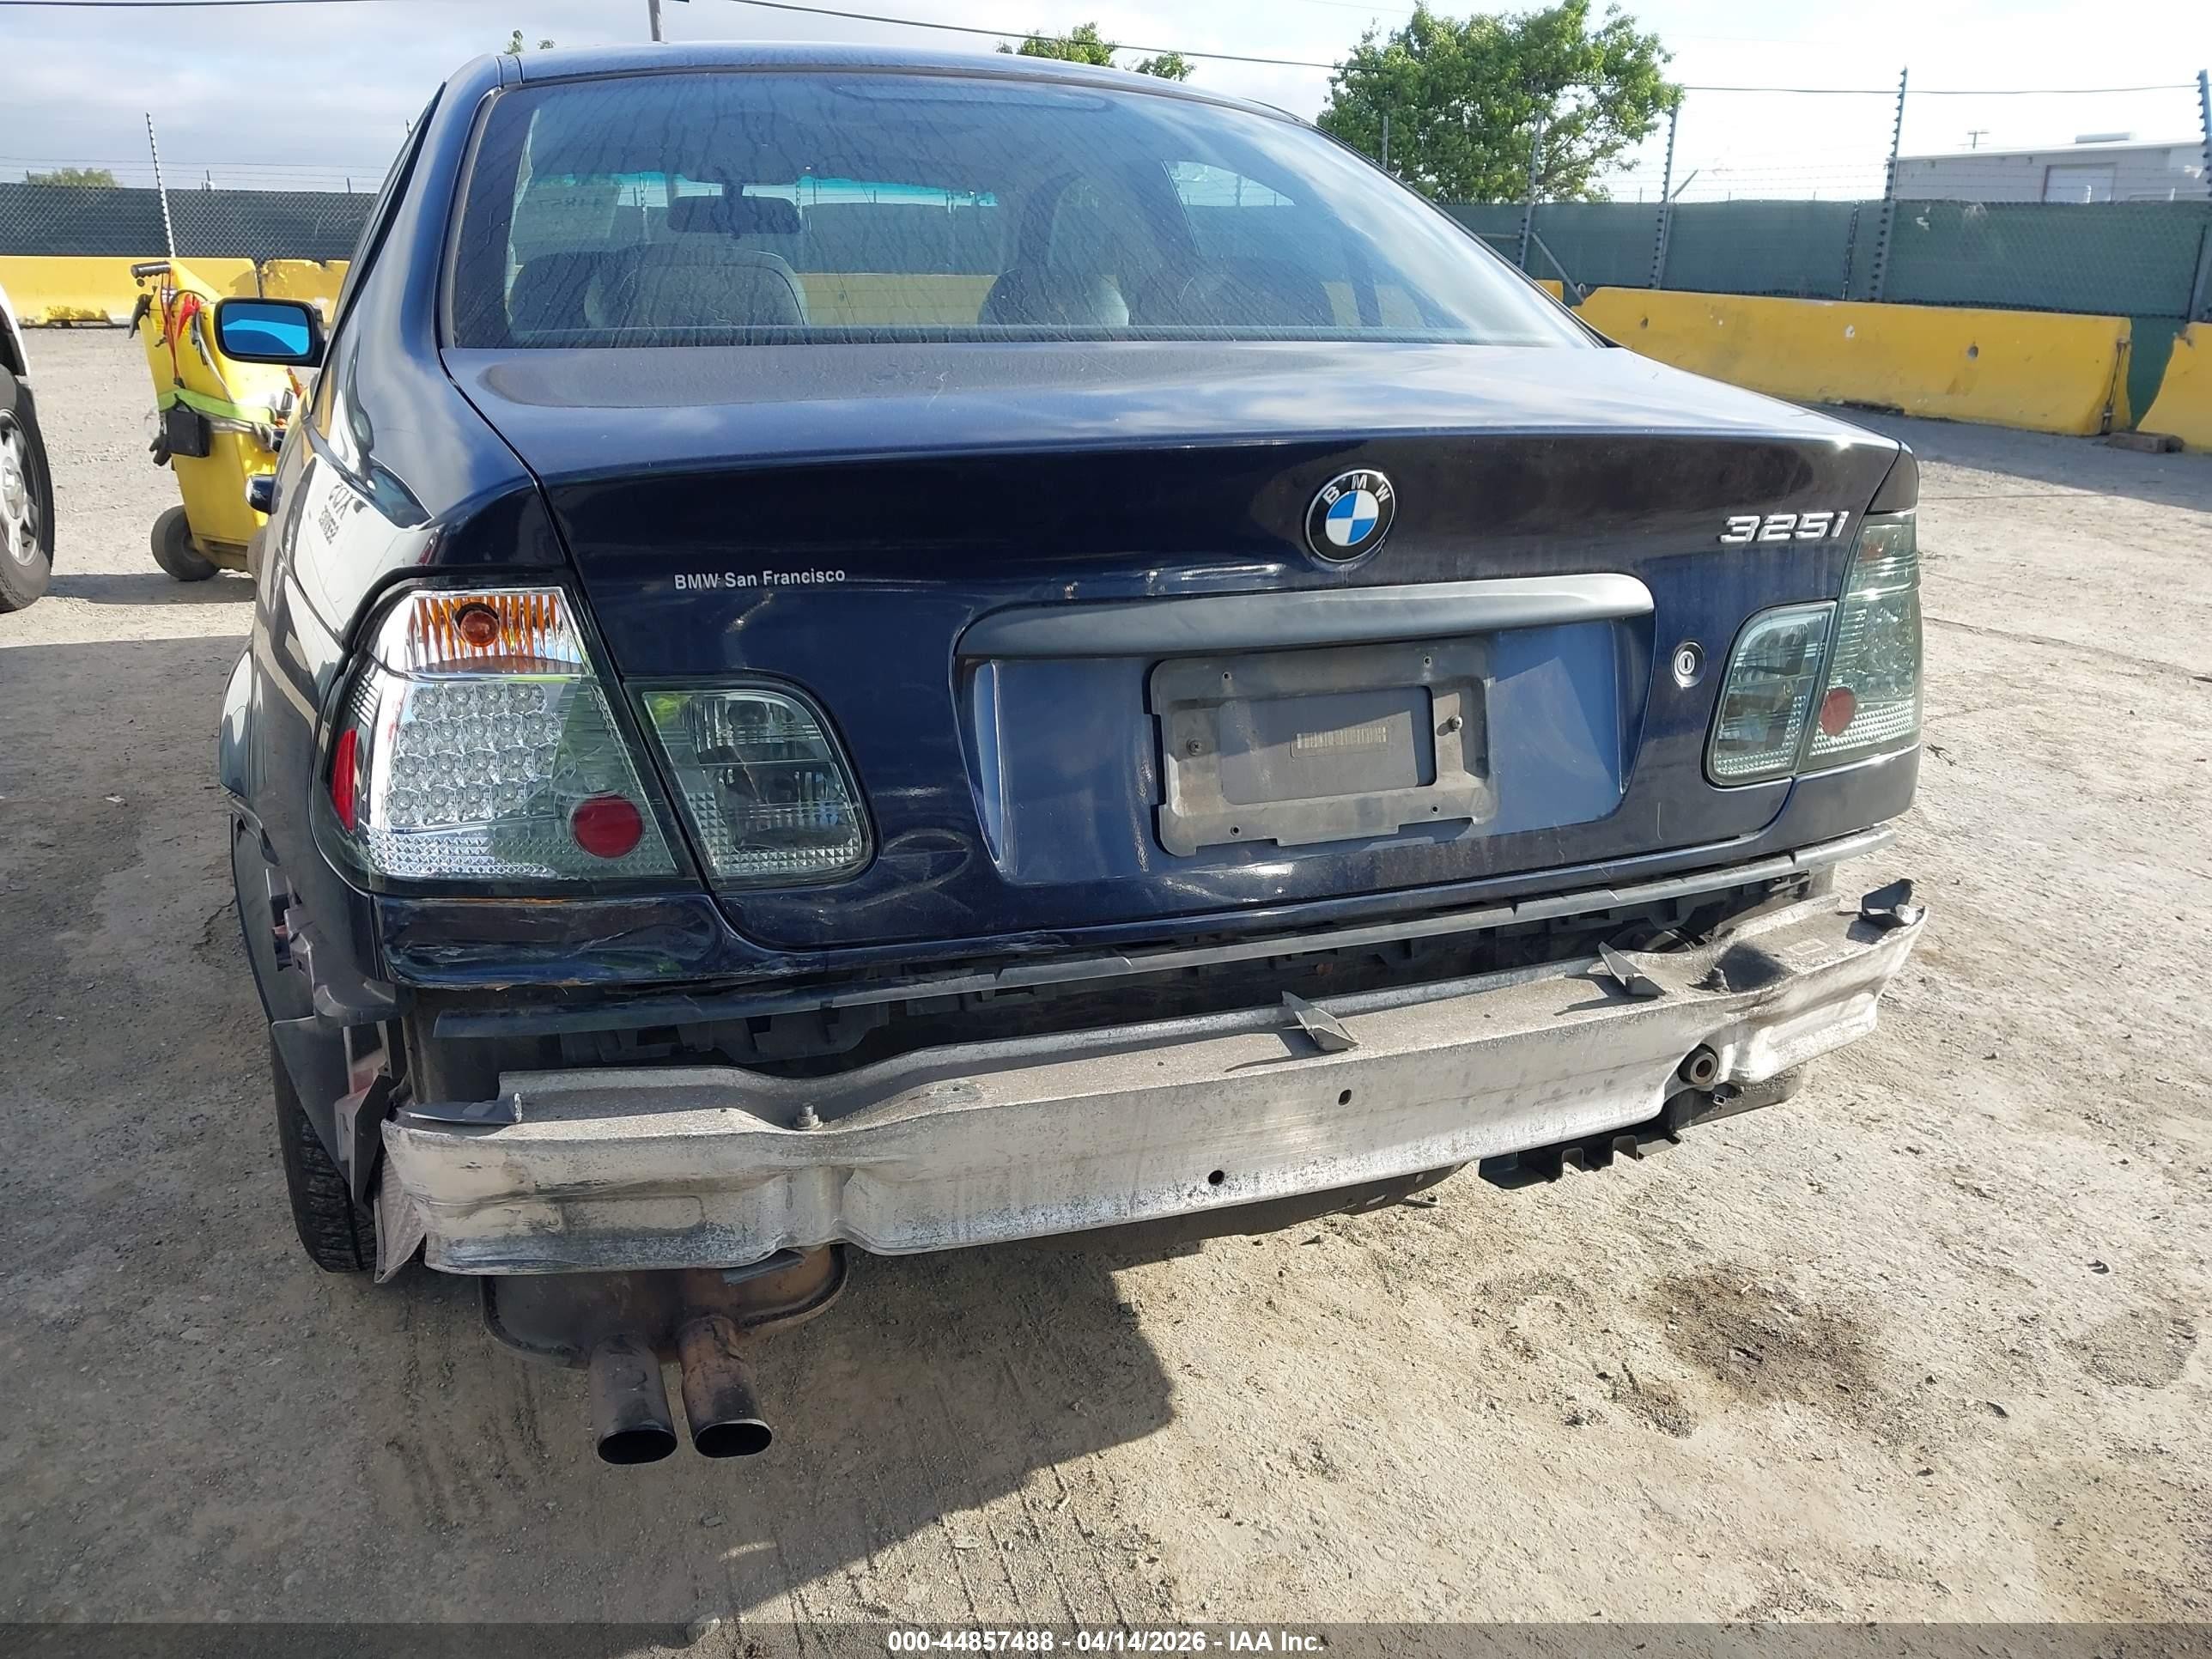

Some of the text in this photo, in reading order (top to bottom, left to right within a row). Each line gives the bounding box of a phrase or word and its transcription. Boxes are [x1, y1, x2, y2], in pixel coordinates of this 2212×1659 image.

[1323, 474, 1390, 505] BMW
[1719, 511, 1850, 543] 325i
[674, 568, 846, 590] BMW San Francisco
